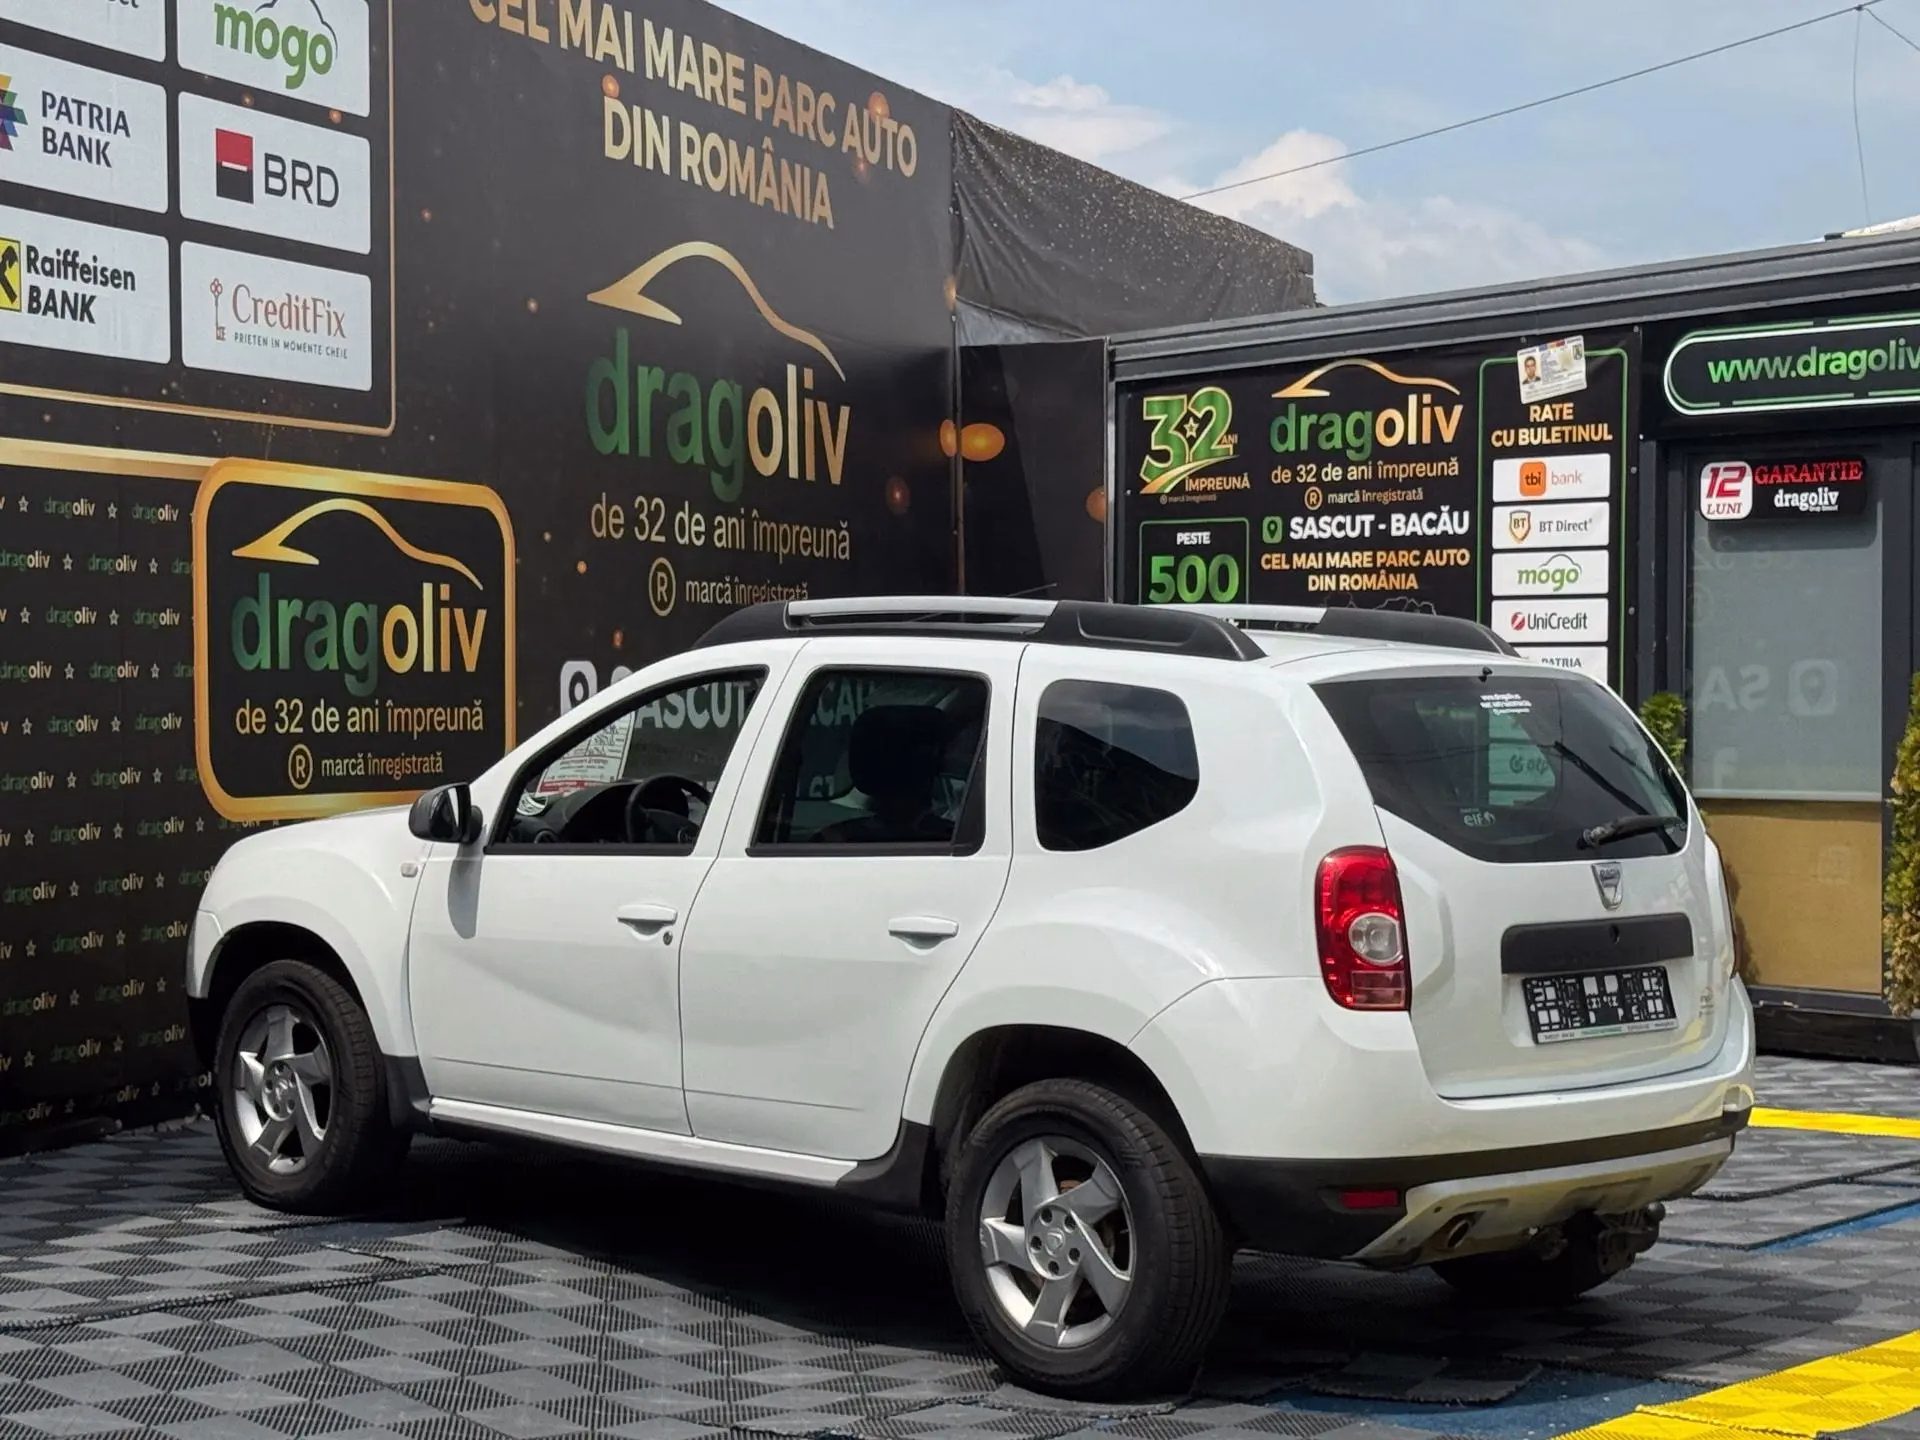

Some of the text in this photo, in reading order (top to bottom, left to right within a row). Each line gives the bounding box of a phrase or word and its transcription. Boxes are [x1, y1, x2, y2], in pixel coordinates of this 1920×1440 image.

[214, 3, 333, 90] mogo
[559, 0, 635, 73] MAI
[643, 18, 747, 115] MARE
[754, 63, 836, 148] PARC
[842, 102, 917, 178] AUTO
[41, 90, 131, 138] PATRIA
[42, 126, 112, 168] BANK
[603, 96, 834, 229] DIN ROMÂNIA
[264, 153, 340, 208] BRD
[26, 246, 137, 291] Raiffeisen
[27, 285, 96, 324] BANK
[232, 284, 347, 339] CreditFix
[586, 327, 851, 503] dragoliv
[1529, 403, 1574, 422] RATE
[1270, 393, 1464, 461] dragoliv
[1491, 423, 1613, 447] CU BULETINUL
[1271, 457, 1459, 484] de 32 de ani împreună
[1525, 472, 1542, 486] tbi
[1551, 470, 1582, 486] bank
[1706, 466, 1747, 499] 12
[1754, 461, 1863, 485] GARANTIE
[1327, 488, 1360, 505] marcă
[1706, 503, 1743, 515] LUNI
[1774, 487, 1839, 512] dragoliv
[44, 497, 179, 525] dragoliv dragoliv
[1289, 514, 1375, 540] SASCUT
[1390, 505, 1470, 537] BACĂU
[591, 493, 851, 565] de 32 de ani împreună
[1176, 531, 1211, 545] PESTE
[1539, 522, 1553, 533] BT
[88, 554, 138, 576] dragoliv
[1261, 548, 1471, 571] CEL MAI MARE PARC AUTO
[685, 575, 732, 605] marcă
[1150, 553, 1240, 604] 500
[1308, 570, 1418, 592] DIN ROMÂNIA
[1517, 568, 1579, 592] mogo
[45, 606, 180, 629] dragoliv dragoliv
[1527, 612, 1588, 631] UniCredit
[231, 572, 487, 697] dragoliv
[89, 661, 139, 683] dragoliv
[48, 713, 182, 736] dragoliv dragoliv
[236, 698, 484, 740] de 32 de ani împreună
[91, 767, 141, 789] dragoliv
[321, 754, 365, 777] marcă
[367, 752, 444, 780] înregistrată
